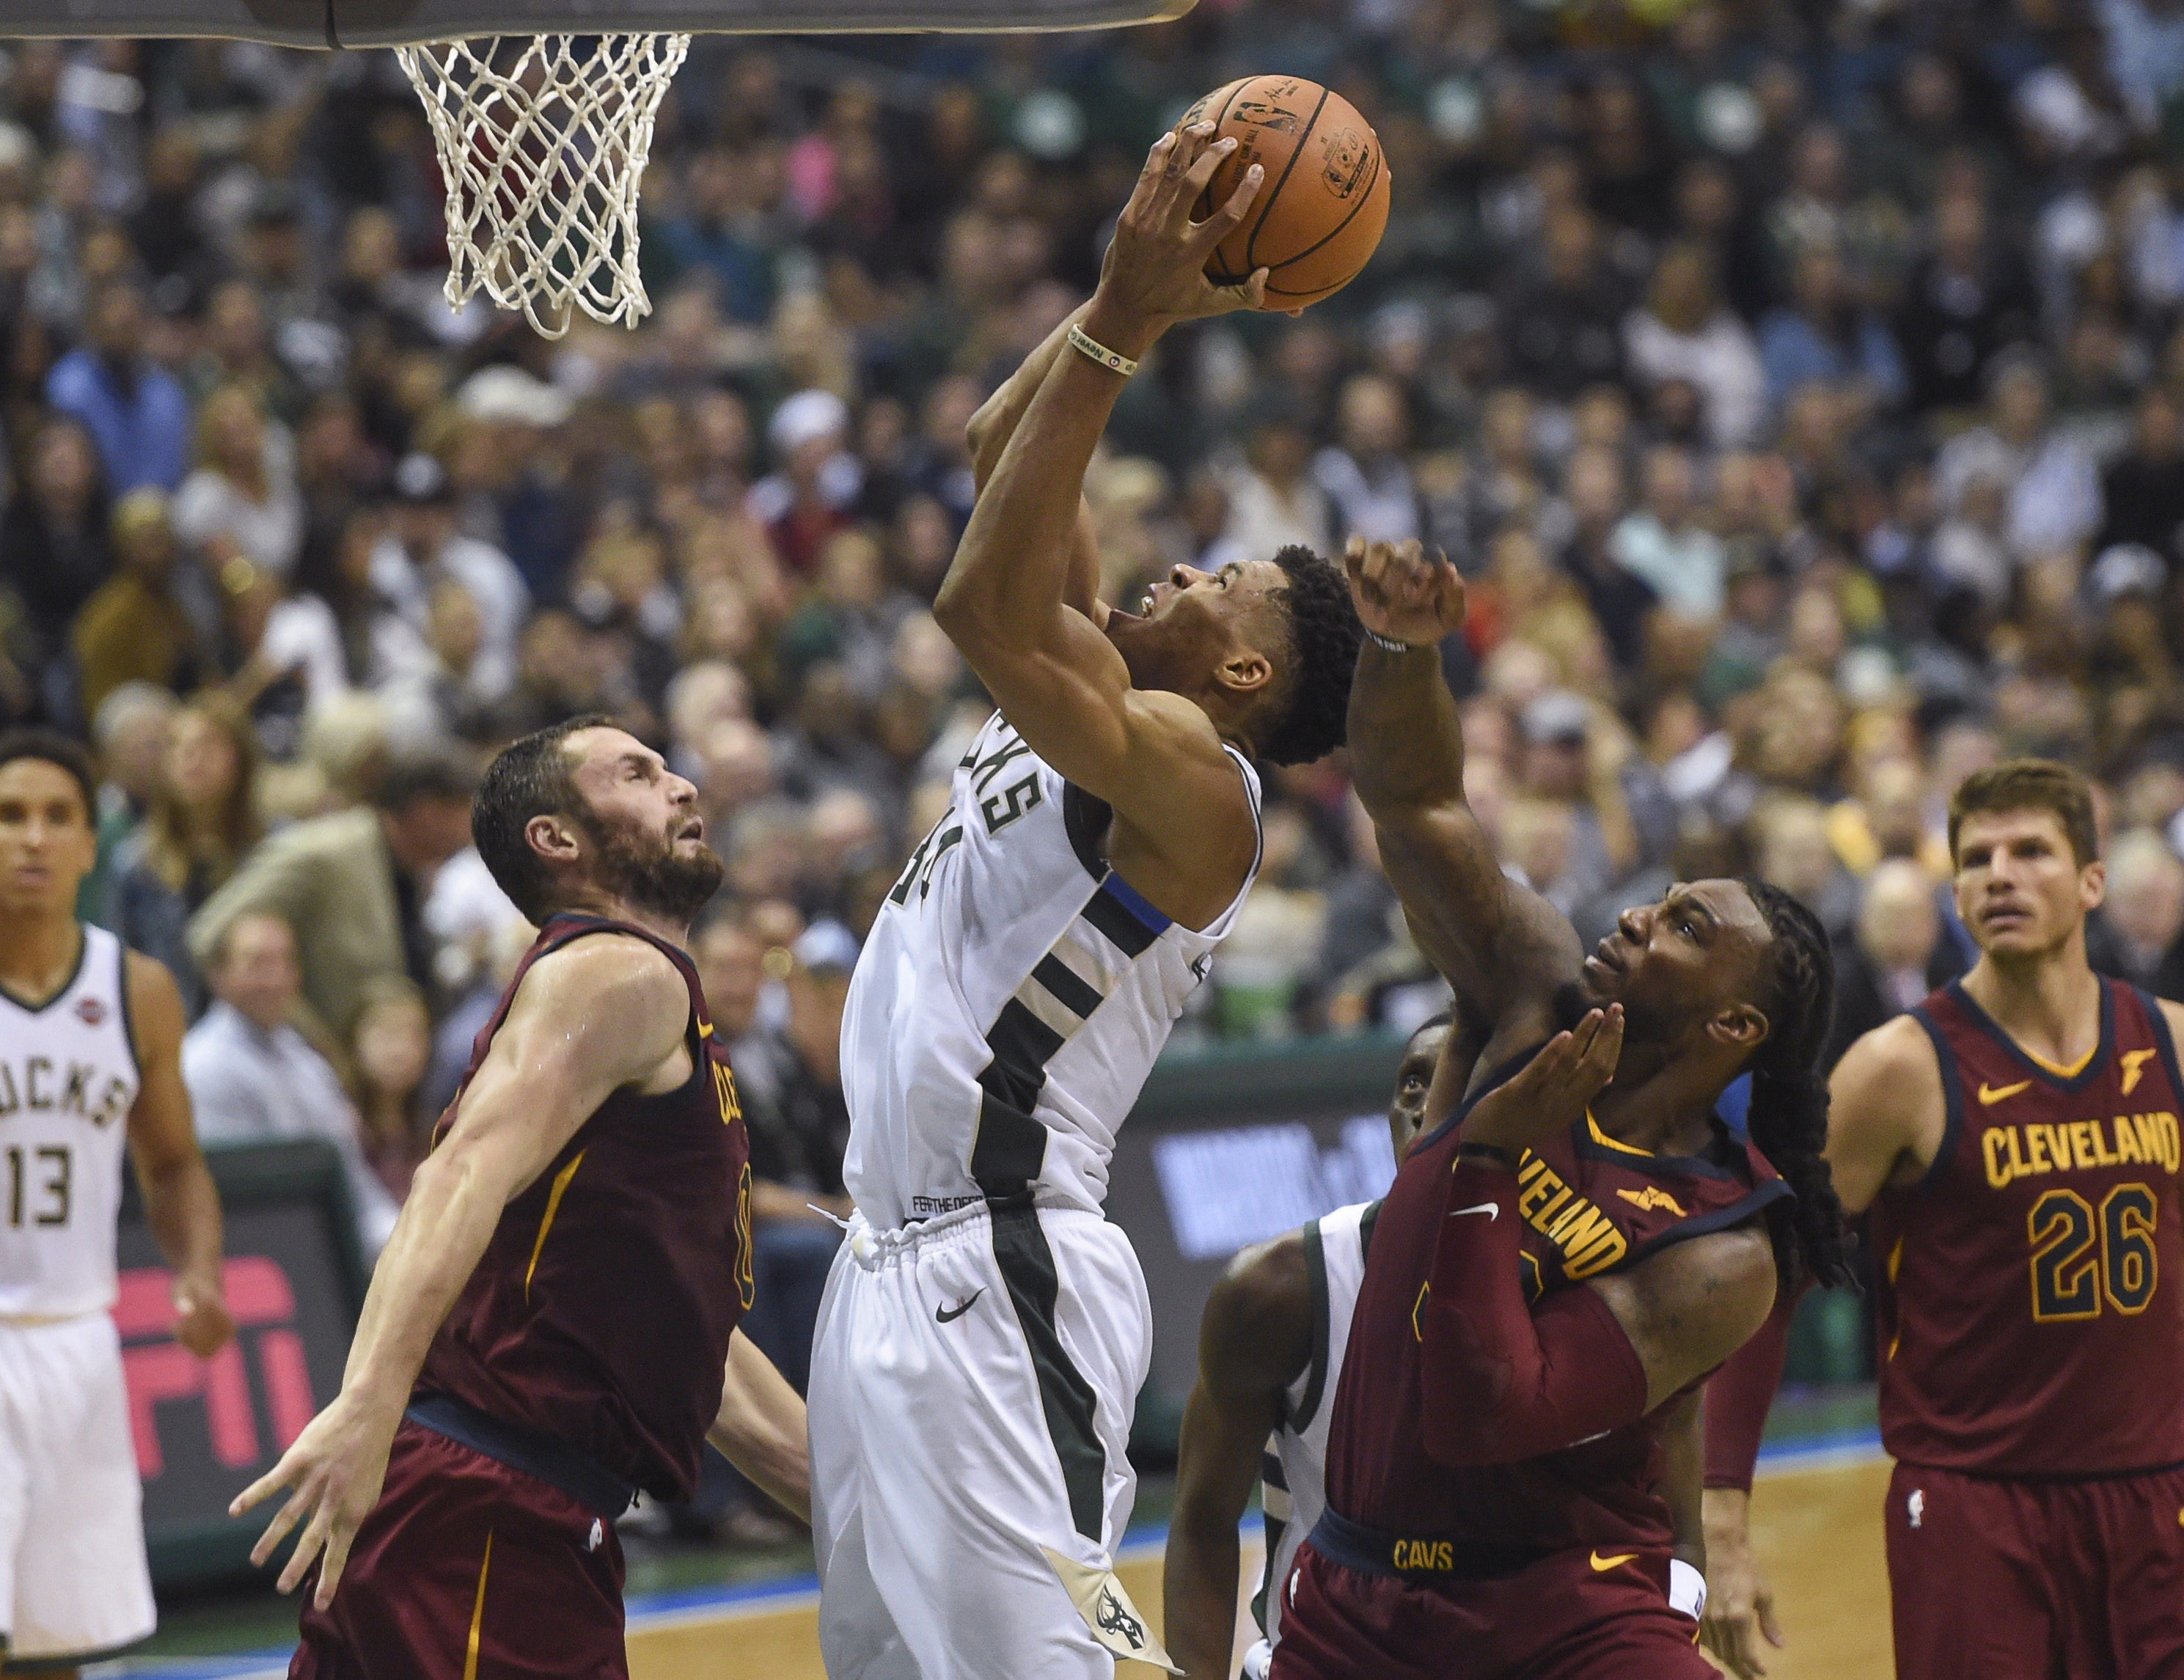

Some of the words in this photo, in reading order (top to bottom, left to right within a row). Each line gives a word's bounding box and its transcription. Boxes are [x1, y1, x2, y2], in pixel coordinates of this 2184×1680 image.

[1077, 337, 1104, 359] Never
[9, 1144, 70, 1228] 13
[1982, 1111, 2181, 1190] CLEVELAND
[2026, 1181, 2158, 1324] 26
[1393, 1539, 1454, 1571] CAVS
